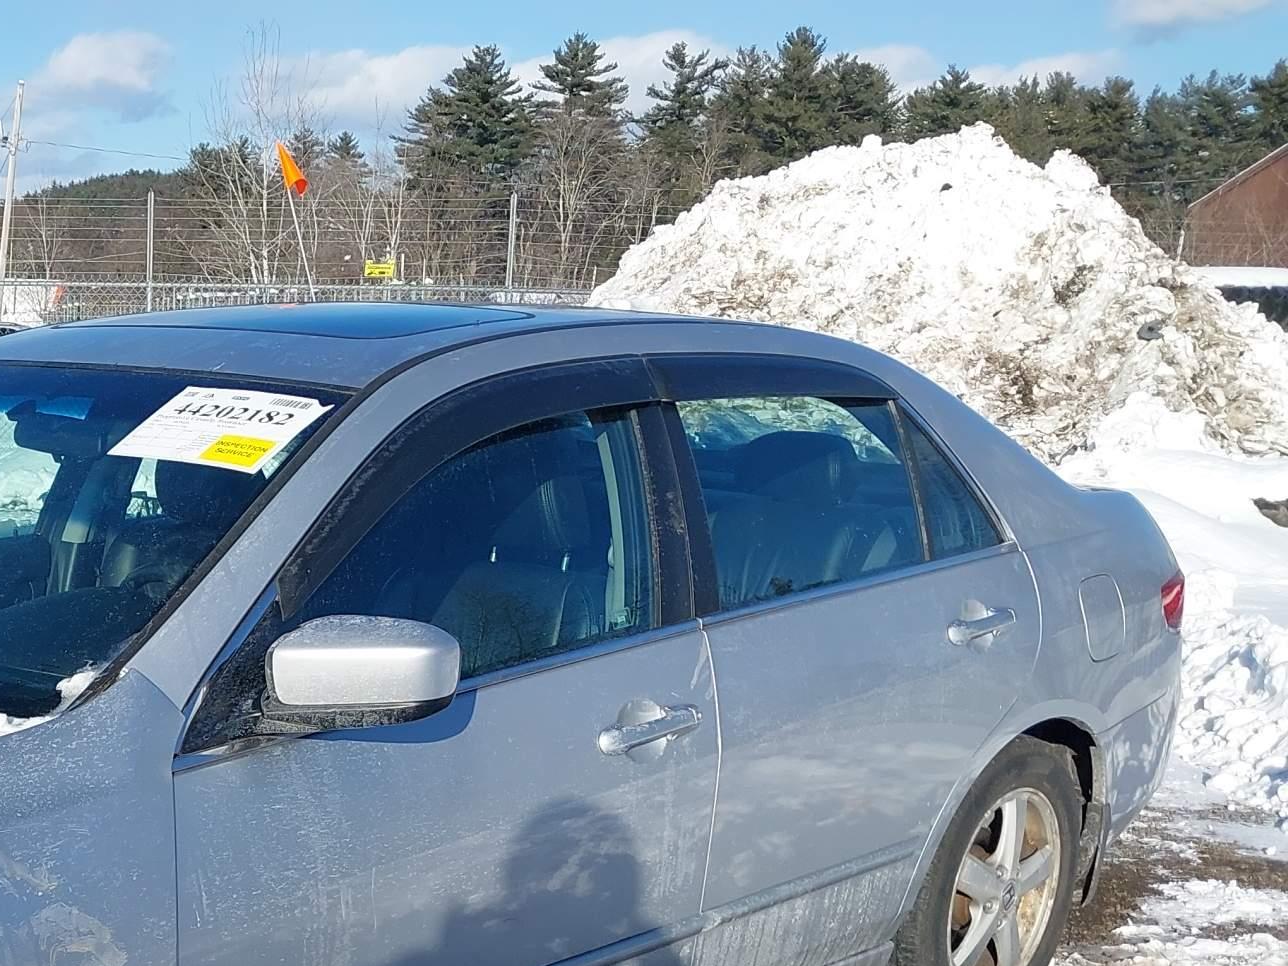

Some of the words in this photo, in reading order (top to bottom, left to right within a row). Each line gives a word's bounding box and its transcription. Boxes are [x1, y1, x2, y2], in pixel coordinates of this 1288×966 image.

[173, 402, 295, 426] 44202182
[215, 440, 269, 453] INSPECTION
[215, 447, 255, 458] SERVICE
